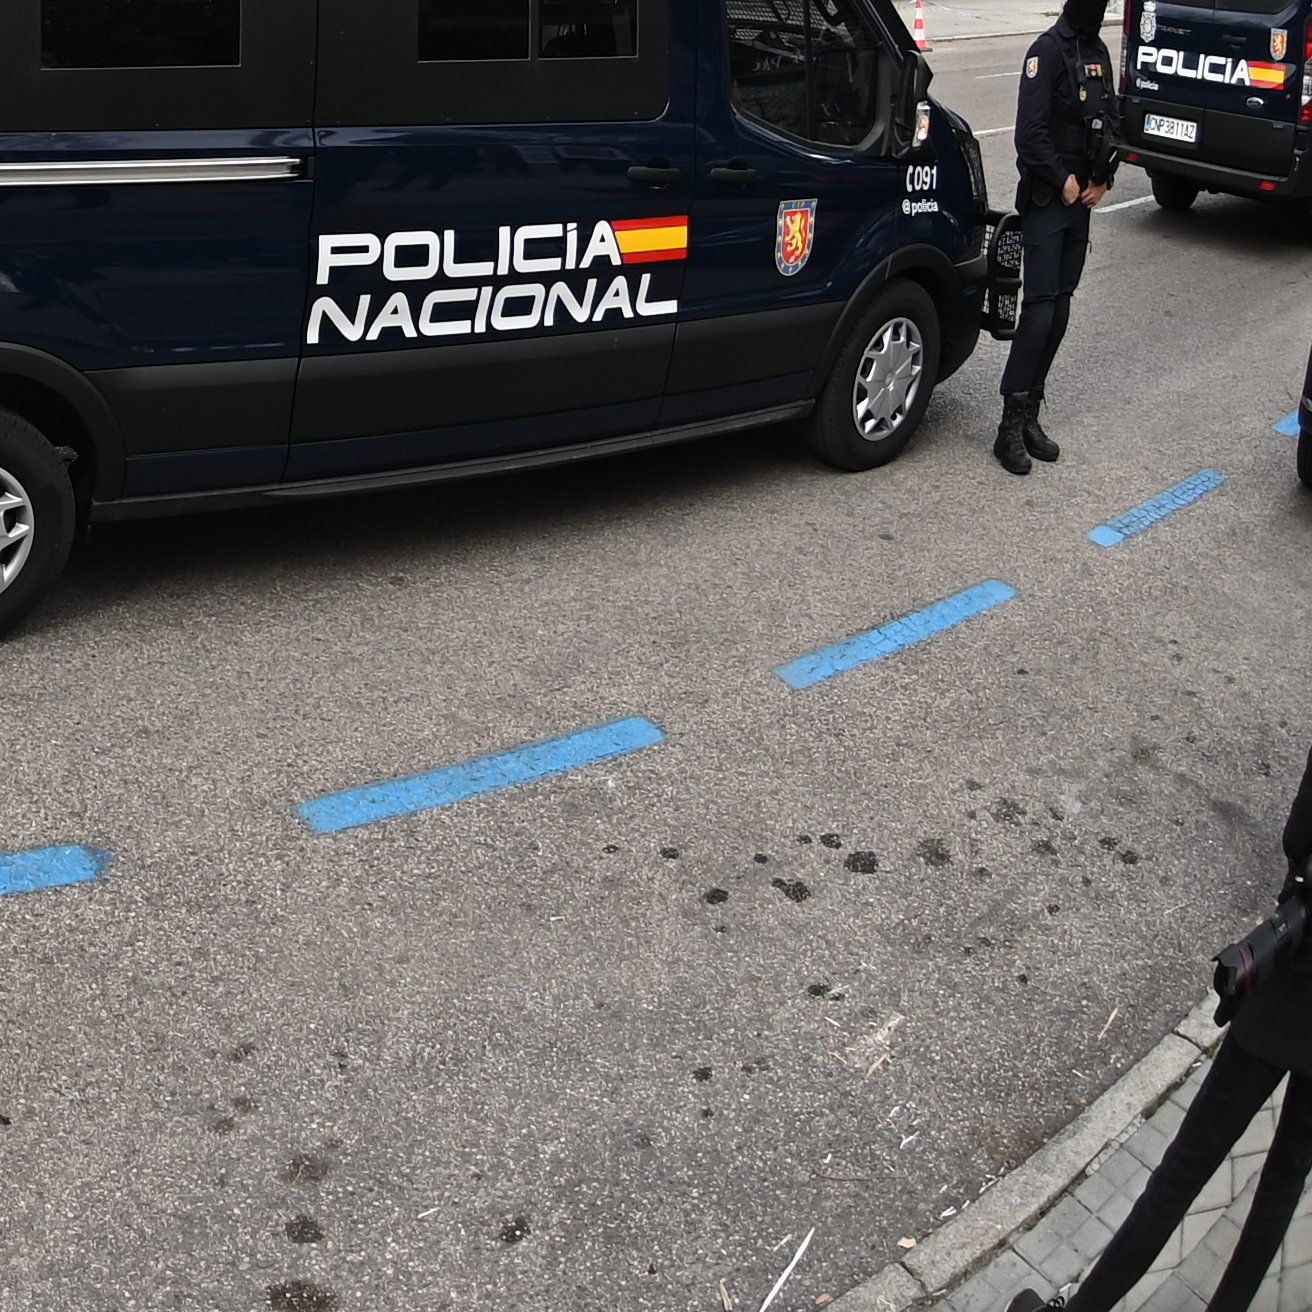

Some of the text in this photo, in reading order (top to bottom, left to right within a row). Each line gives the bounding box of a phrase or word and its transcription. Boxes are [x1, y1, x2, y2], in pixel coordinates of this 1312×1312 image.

[914, 165, 937, 191] 091
[901, 198, 939, 217] @policia
[307, 273, 679, 345] NACIONAL
